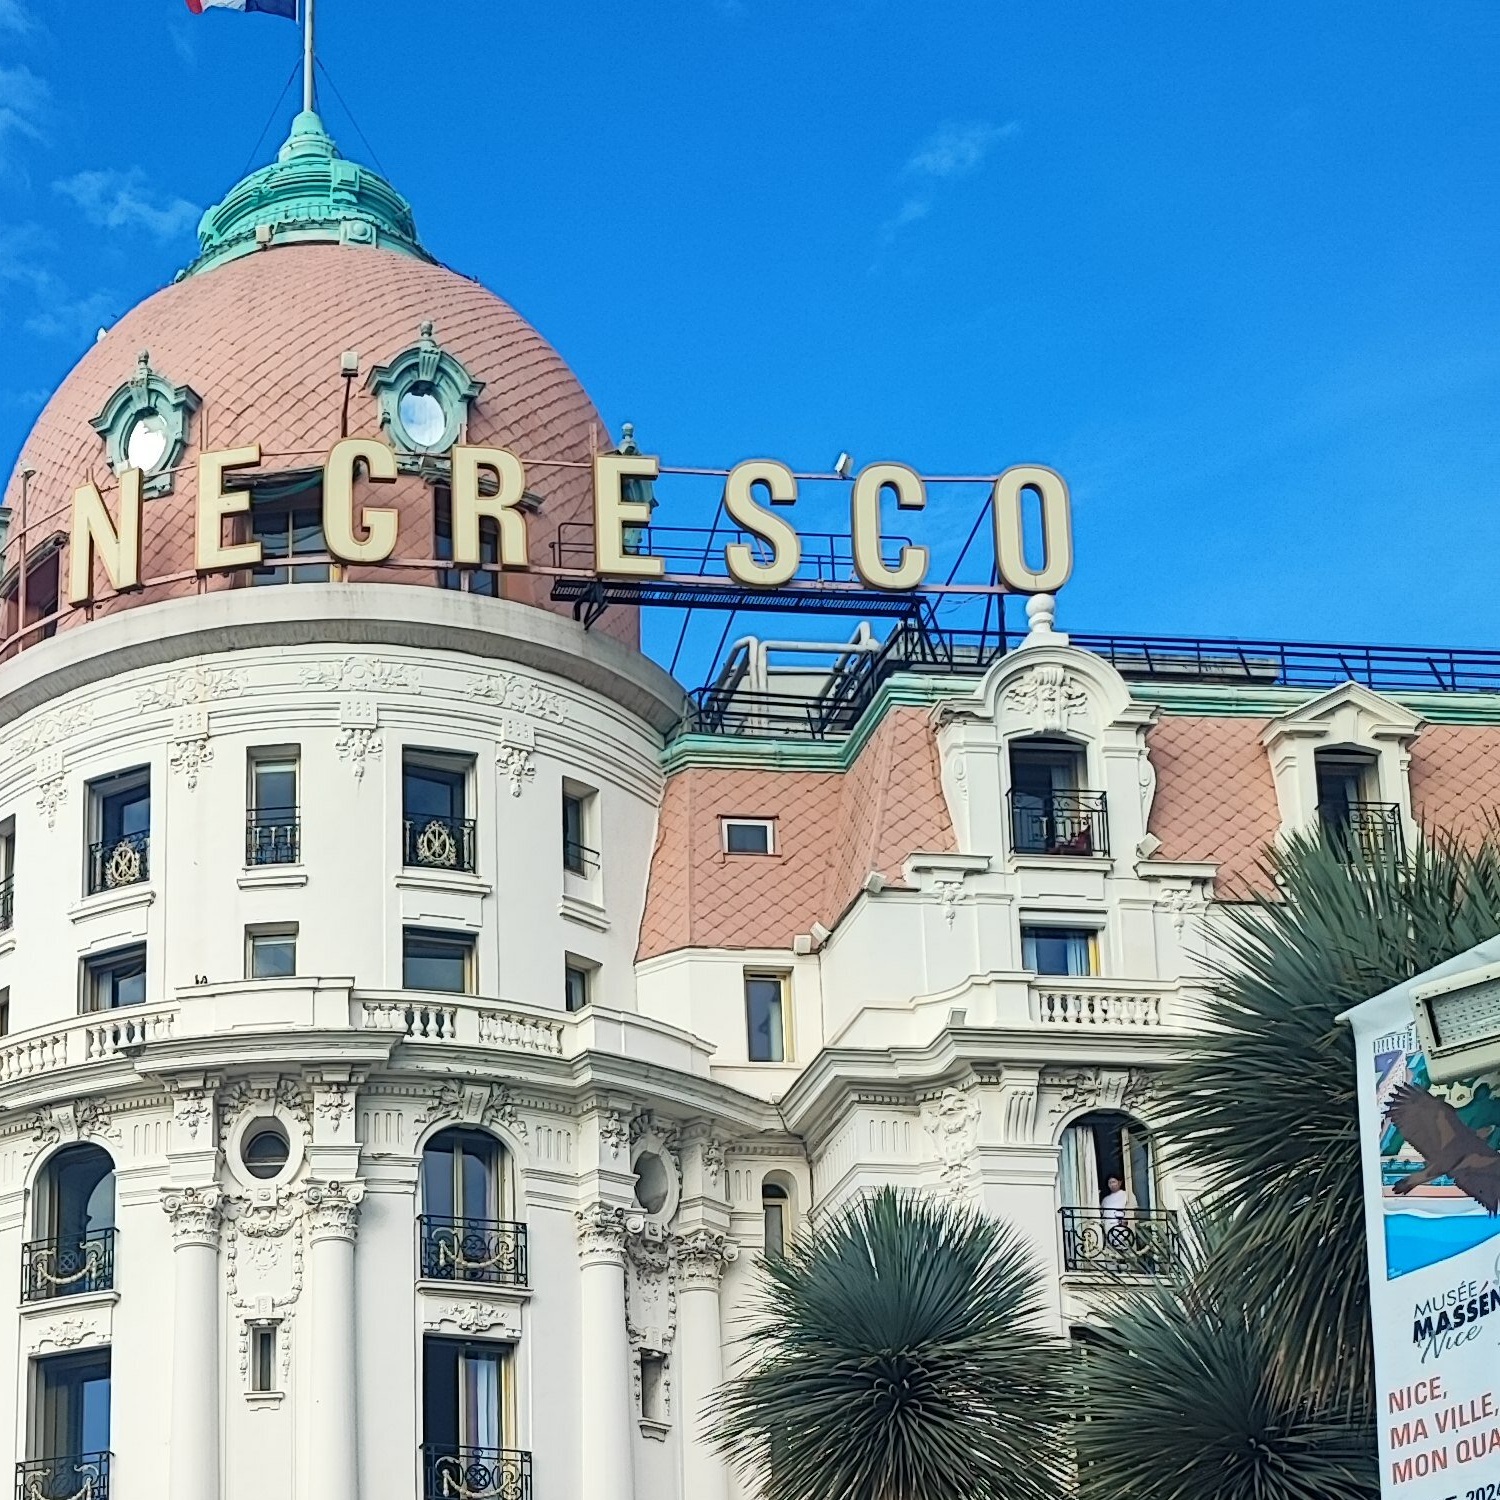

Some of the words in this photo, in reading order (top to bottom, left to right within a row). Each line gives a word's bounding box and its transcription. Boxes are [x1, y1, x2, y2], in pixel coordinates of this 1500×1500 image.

[70, 438, 1074, 606] NEGRESCO
[1414, 1280, 1478, 1319] MUSÉE
[1417, 1324, 1483, 1364] Nice
[1388, 1376, 1448, 1414] NICE,
[1390, 1418, 1429, 1450] MA
[1435, 1392, 1499, 1434] VILLE,
[1392, 1446, 1448, 1485] MON
